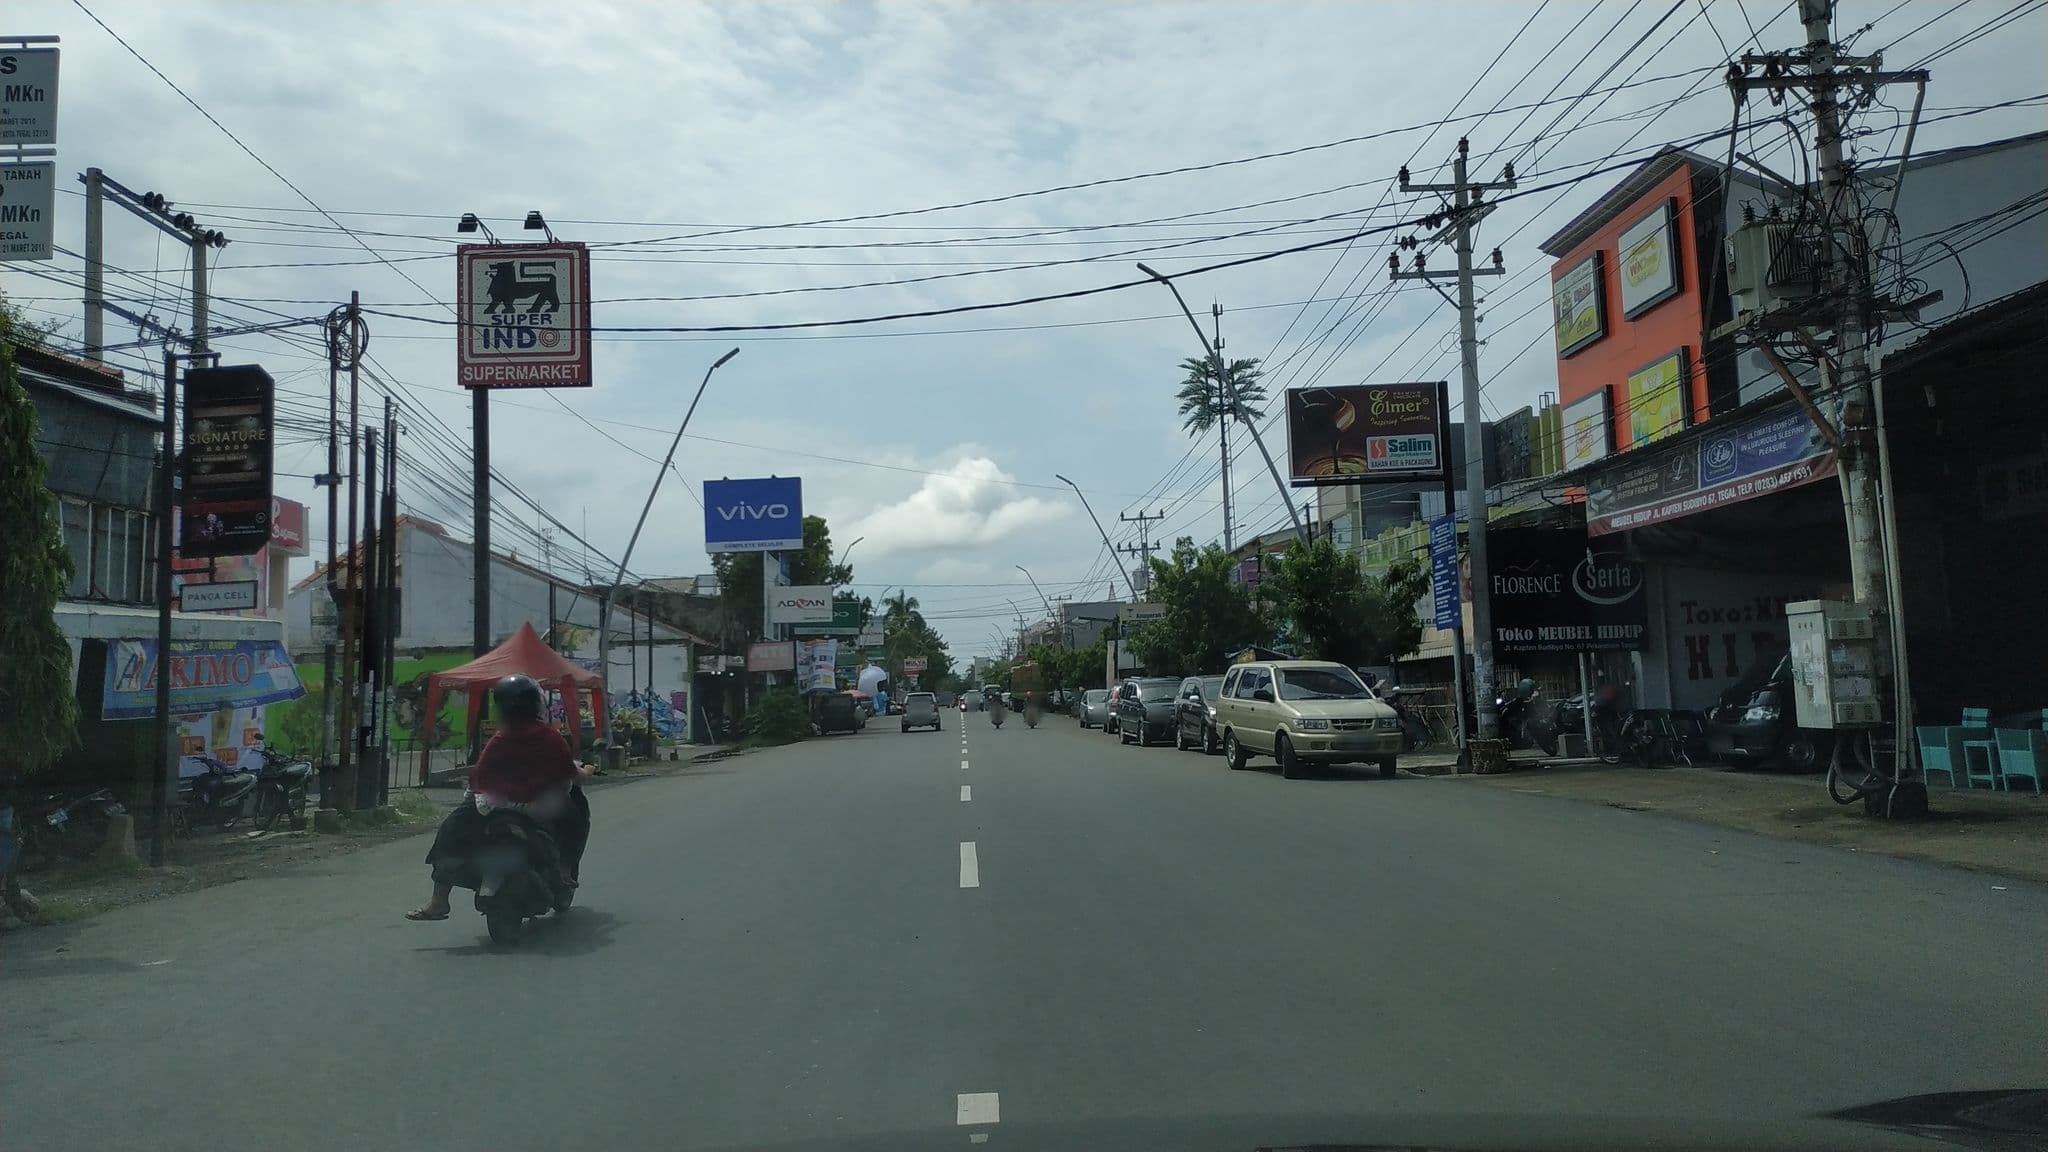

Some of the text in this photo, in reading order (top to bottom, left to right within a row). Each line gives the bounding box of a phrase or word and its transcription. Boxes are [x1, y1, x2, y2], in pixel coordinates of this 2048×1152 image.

[5, 84, 44, 102] MKn
[4, 170, 41, 180] TANAH
[1, 204, 40, 223] MKn
[491, 313, 553, 326] SUPER
[463, 364, 582, 381] SUPERMARKET
[189, 429, 267, 446] SIGNATURE
[1778, 425, 1805, 440] SLEEPING
[1388, 438, 1433, 453] Salim
[1717, 488, 1737, 502] TEGAL
[1754, 474, 1778, 493] (0283)
[717, 500, 789, 521] vivo
[1493, 563, 1631, 595] FLORENCE Serta
[187, 592, 249, 601] PANCA CELL
[777, 598, 825, 609] ADVAN
[1537, 625, 1593, 641] MEUBEL
[1597, 624, 1644, 639] HIDUP
